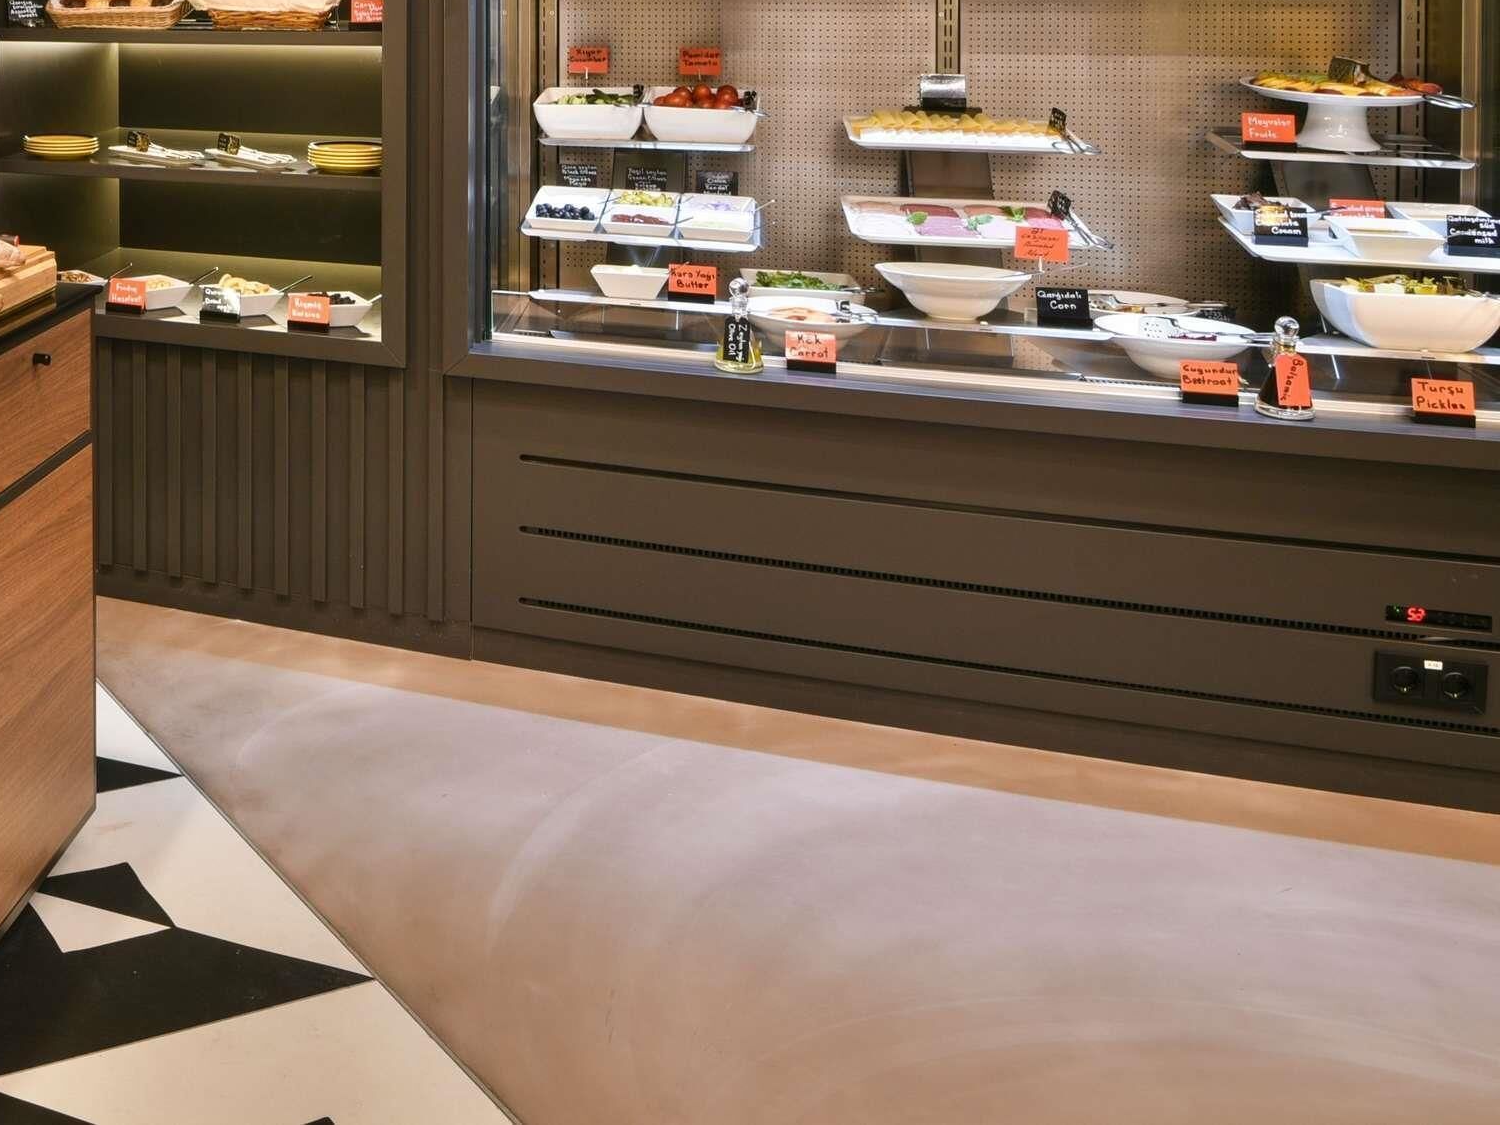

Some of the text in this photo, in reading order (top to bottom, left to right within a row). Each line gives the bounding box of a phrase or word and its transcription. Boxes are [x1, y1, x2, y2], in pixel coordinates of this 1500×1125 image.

[1249, 128, 1277, 139] Fruits
[1271, 226, 1302, 236] Cream
[677, 279, 709, 288] Butter
[1050, 300, 1077, 310] Corn
[790, 346, 829, 358] Carrot
[1416, 395, 1466, 410] Pickles
